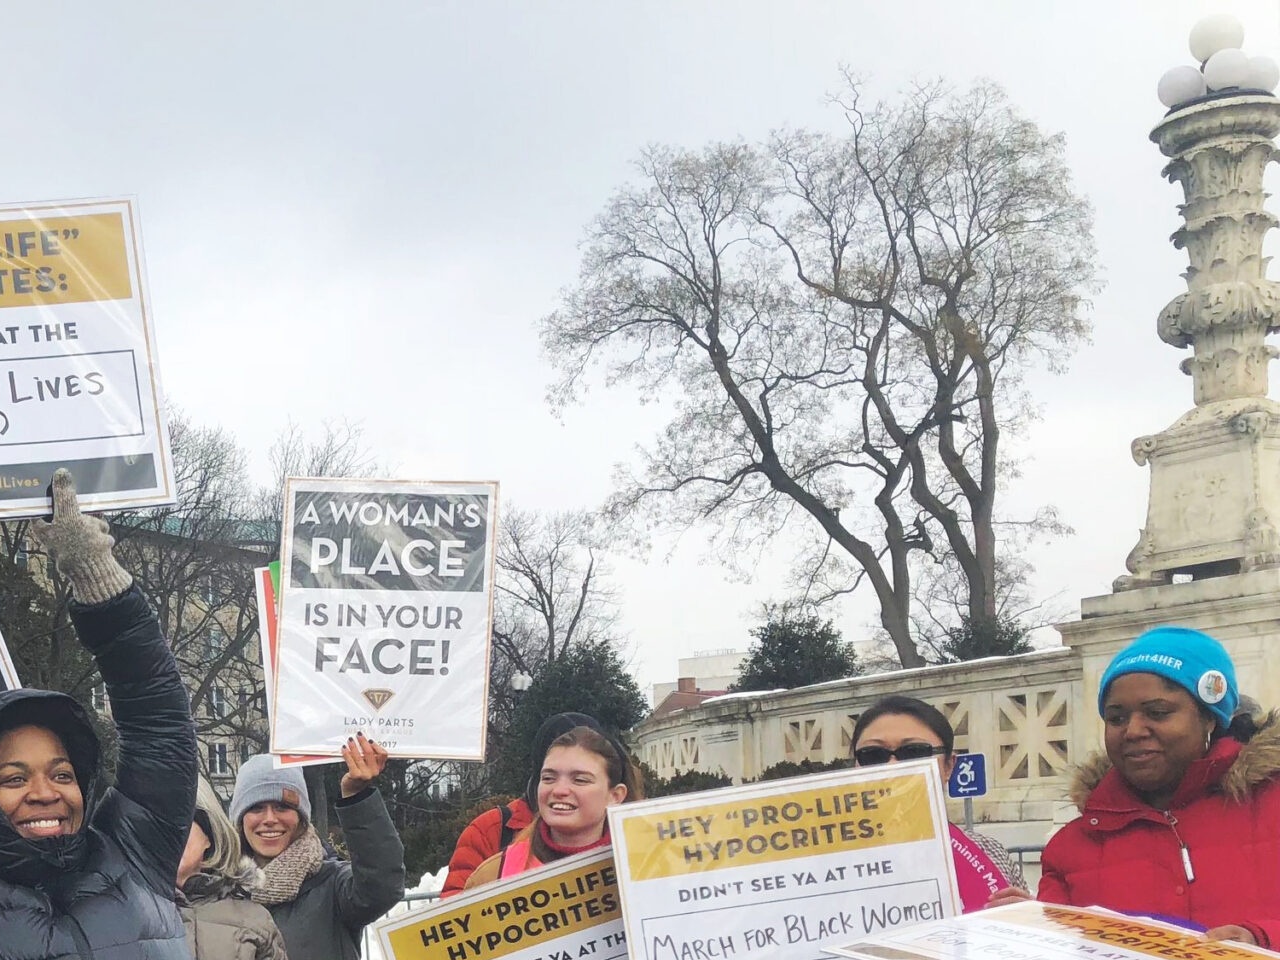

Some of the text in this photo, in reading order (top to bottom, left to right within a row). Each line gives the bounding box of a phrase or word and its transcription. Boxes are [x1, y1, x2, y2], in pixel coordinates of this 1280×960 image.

[28, 322, 78, 342] THE
[300, 501, 481, 528] A WOMAN’S
[310, 537, 466, 577] PLACE
[304, 603, 463, 629] IS IN YOUR
[315, 636, 450, 676] FACE!
[344, 716, 414, 727] LADY PARTS
[657, 788, 893, 842] HEY “PRO-LIFE”
[683, 818, 884, 865] HYPOCRITES:
[951, 838, 985, 873] minist
[679, 860, 894, 903] DIDN'T SEE YA AT THE
[420, 866, 617, 947] HEY “PRO-LIFE
[578, 940, 599, 957] AT
[603, 931, 627, 948] TH
[744, 928, 776, 952] FOR
[784, 911, 855, 946] BLACK
[861, 899, 945, 935] Women
[1076, 944, 1097, 954] YA
[1100, 951, 1123, 960] AT
